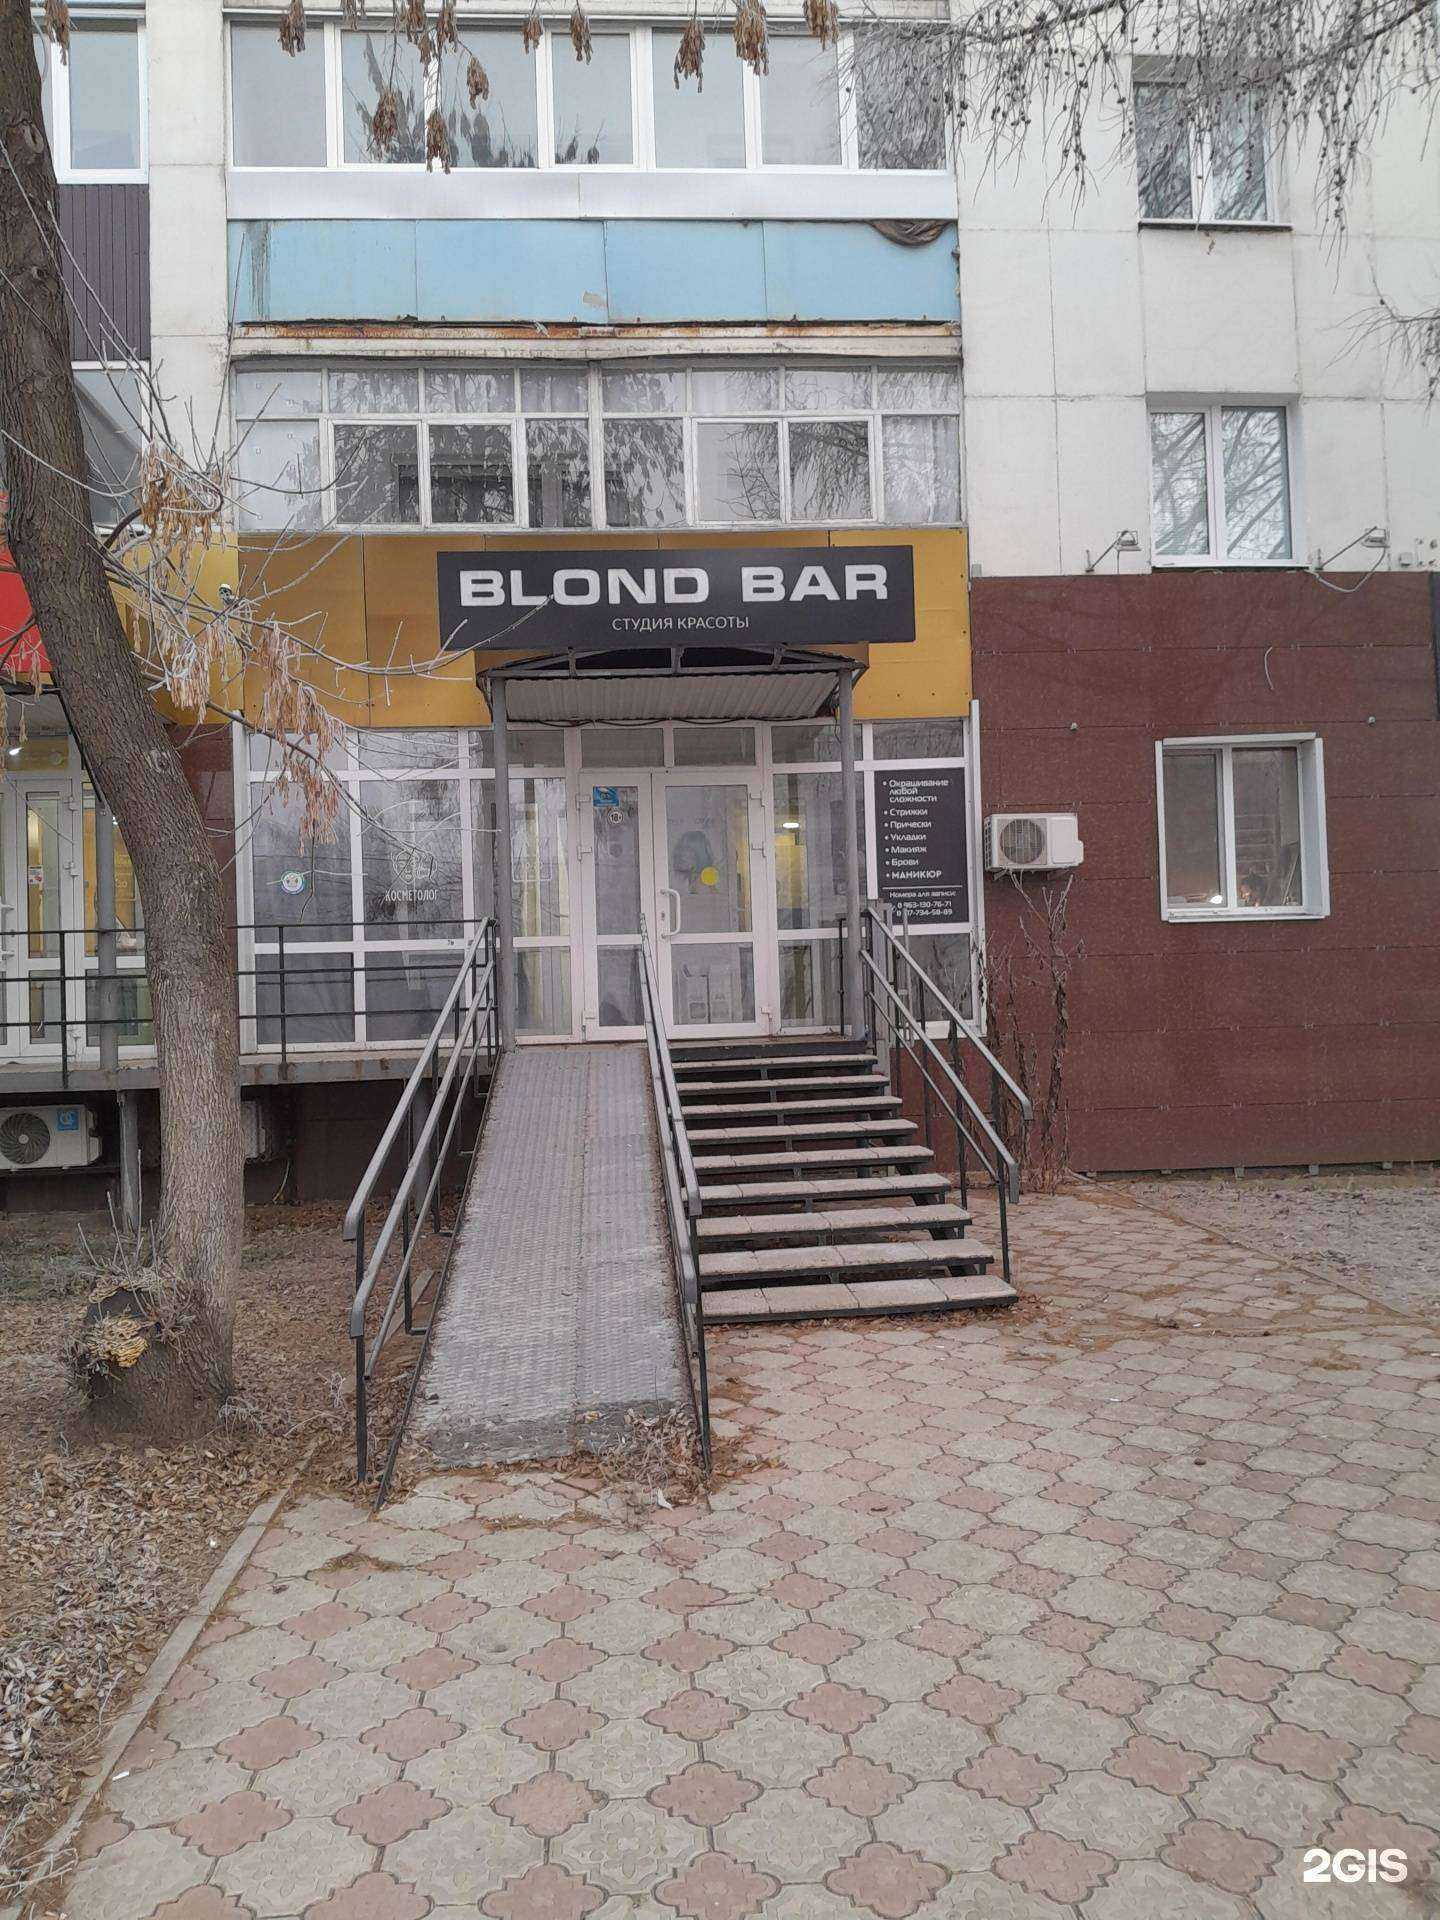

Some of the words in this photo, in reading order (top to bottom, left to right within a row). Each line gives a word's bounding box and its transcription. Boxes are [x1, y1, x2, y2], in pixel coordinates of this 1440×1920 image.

[460, 567, 710, 607] BLOND
[742, 564, 888, 602] BAR
[612, 617, 673, 632] СТУДИЯ
[678, 615, 749, 630] КРАСОТЫ
[890, 809, 928, 817] Стрижки
[890, 821, 932, 829] Прически
[891, 858, 919, 867] Брови
[892, 870, 942, 879] МАНИКЮР
[385, 889, 438, 901] КОСМЕТОЛОГ
